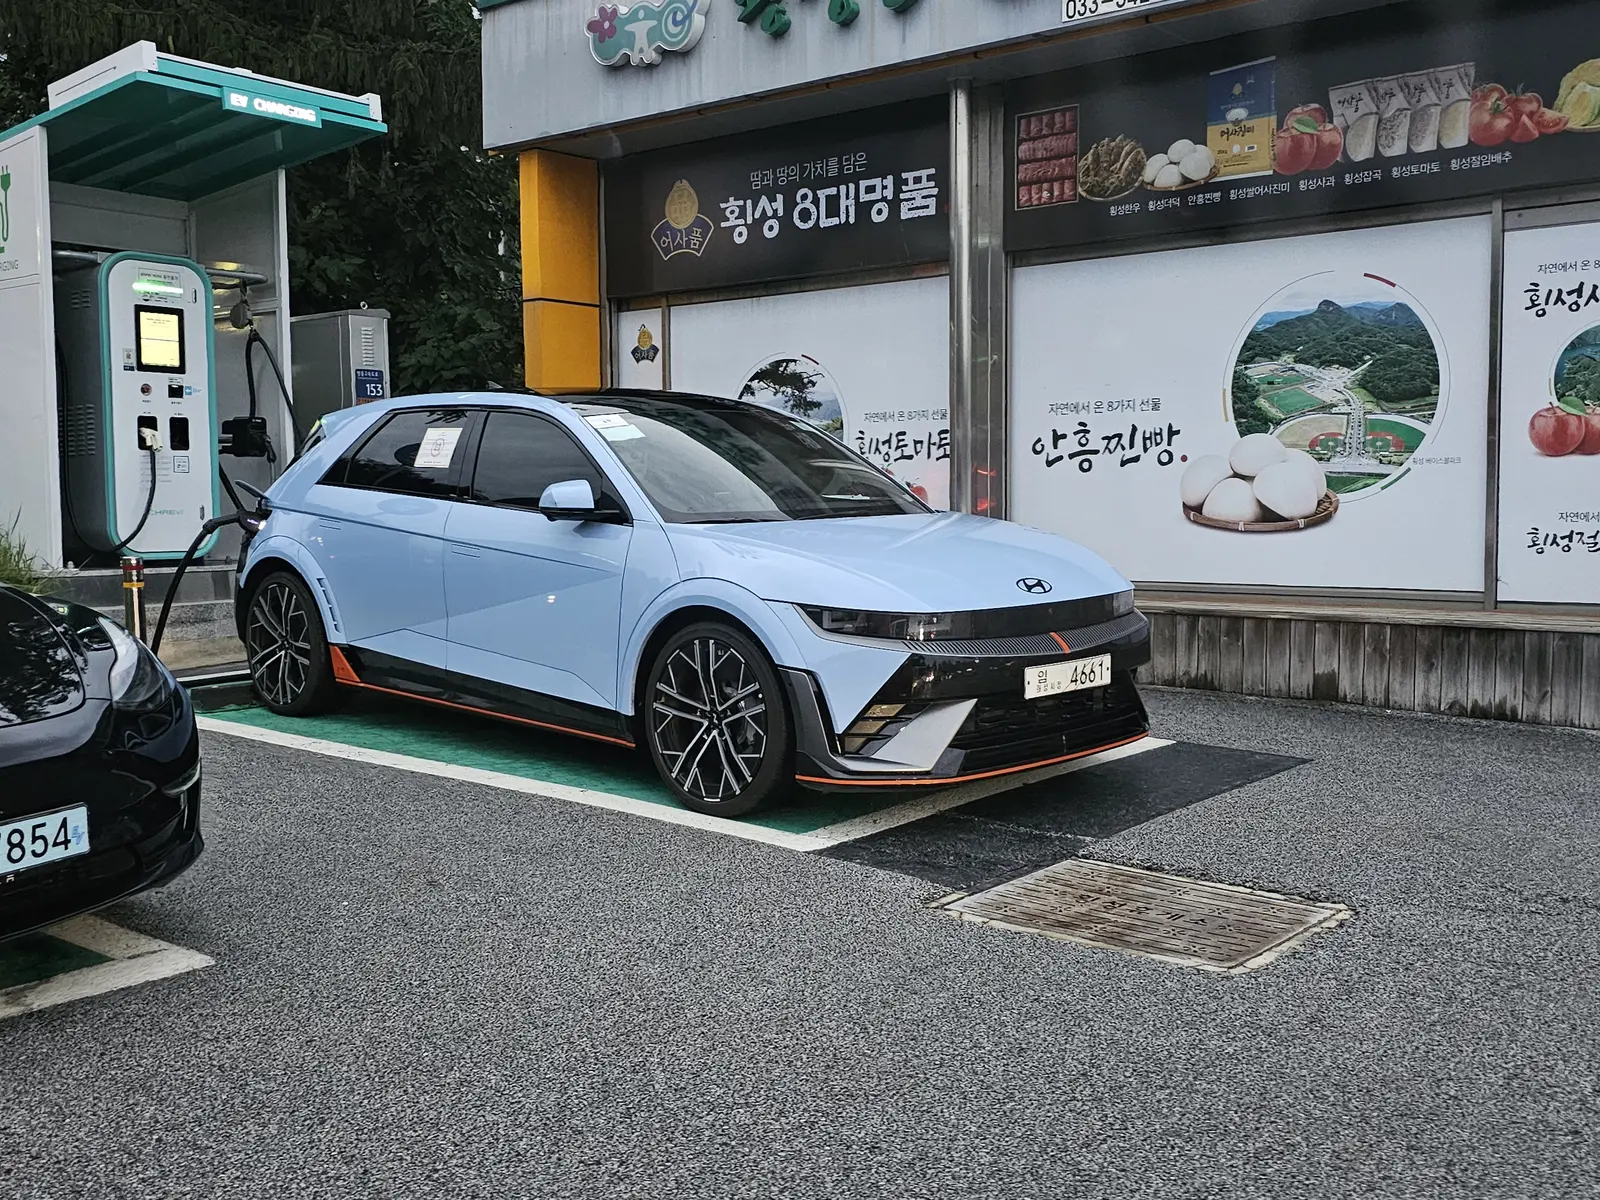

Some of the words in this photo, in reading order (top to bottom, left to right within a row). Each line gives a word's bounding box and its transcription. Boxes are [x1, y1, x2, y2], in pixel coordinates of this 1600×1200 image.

[230, 92, 248, 108] EV
[253, 97, 317, 122] CHARGING
[750, 168, 774, 190] 땀과
[776, 163, 800, 186] 땅의
[803, 156, 840, 180] 가치를
[842, 152, 868, 175] 담은
[1109, 202, 1141, 217] 횡성한우
[1147, 196, 1181, 212] 횡성더덕
[1187, 191, 1222, 206] 안흥찐빵
[1298, 175, 1335, 191] 횡성사과
[1343, 169, 1383, 185] 횡성잡곡
[1390, 161, 1441, 179] 횡성토마토
[1449, 150, 1513, 171] 횡성절임배추
[719, 193, 784, 245] 횡성
[660, 227, 704, 252] 어사품
[0, 259, 19, 272] GING
[1537, 260, 1578, 275] 자연에서
[1580, 259, 1591, 271] 온
[365, 383, 383, 396] 153
[863, 410, 895, 423] 자연에서
[897, 410, 906, 422] 온
[931, 408, 949, 421] 선물
[1048, 401, 1091, 416] 자연에서
[1093, 400, 1105, 414] 온
[1106, 398, 1136, 413] 8가지
[1139, 397, 1162, 412] 선물
[1558, 511, 1600, 523] 자연에서
[1037, 669, 1048, 684] 임
[1070, 659, 1104, 687] 4661
[0, 815, 72, 865] 854
